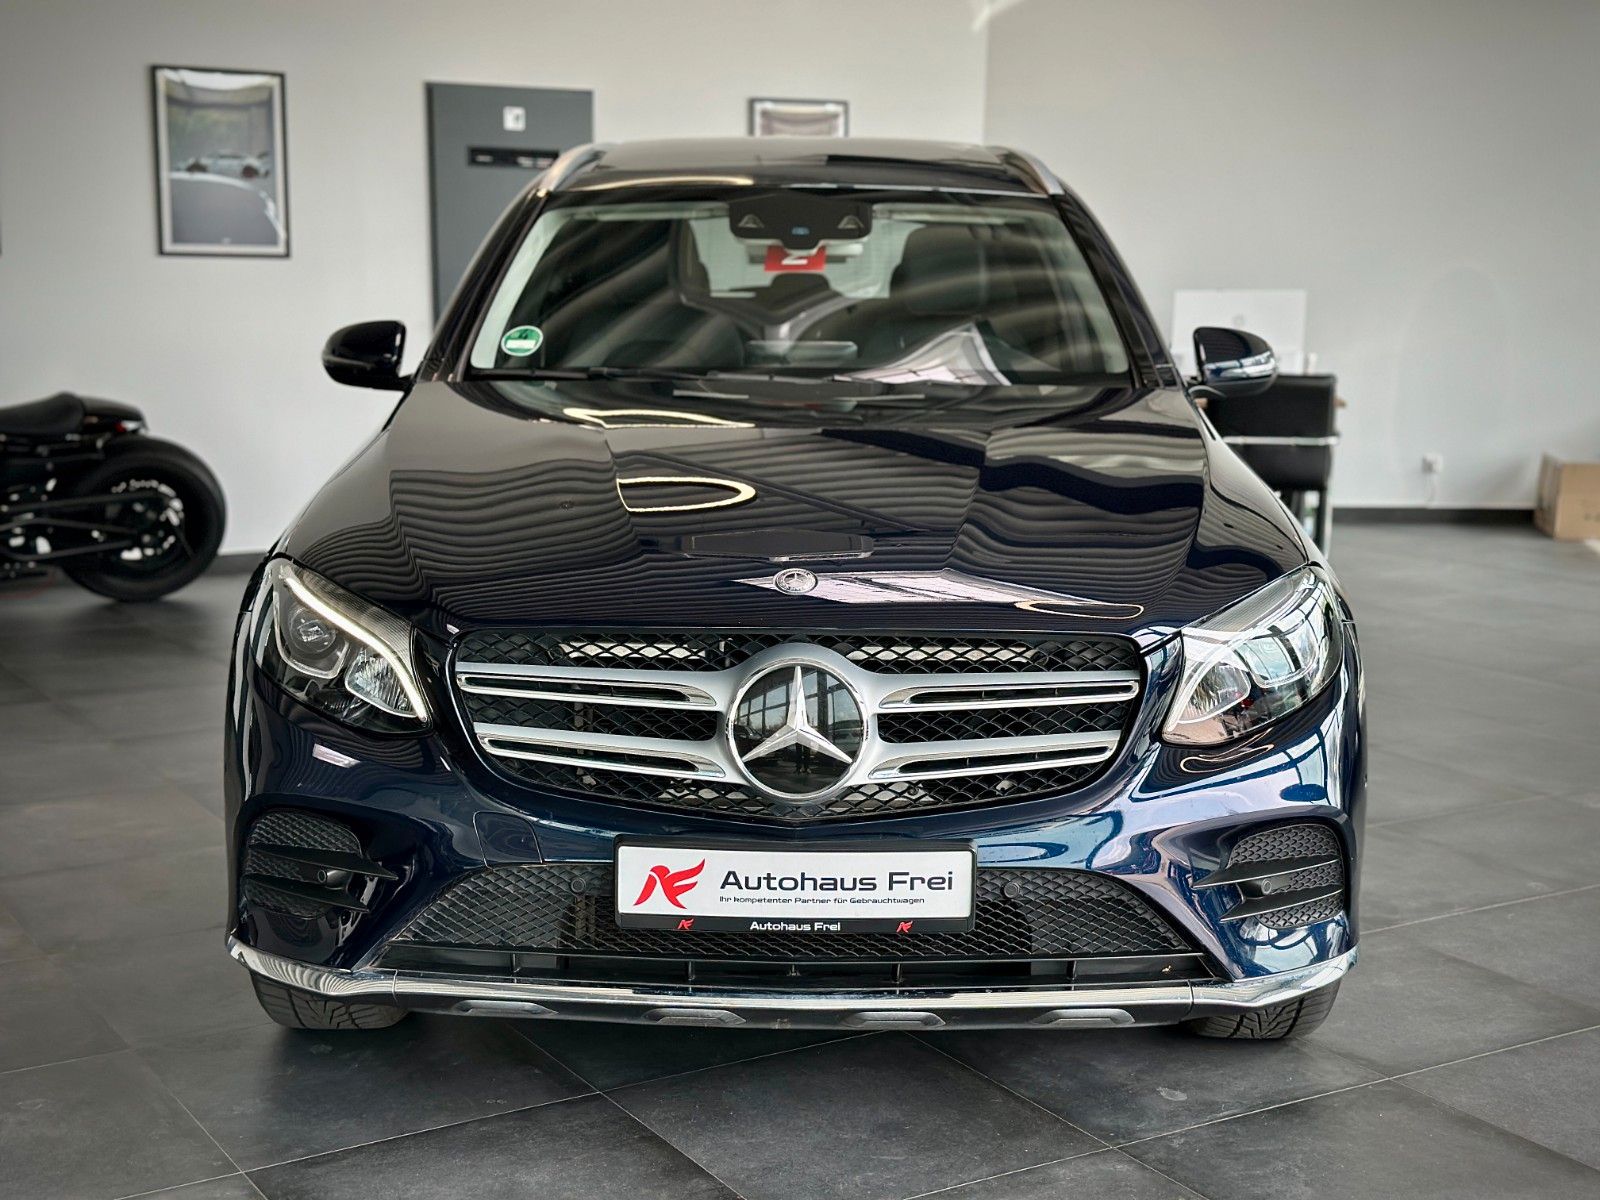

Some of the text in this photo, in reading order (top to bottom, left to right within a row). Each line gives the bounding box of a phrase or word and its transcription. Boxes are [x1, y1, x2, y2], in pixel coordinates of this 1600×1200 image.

[720, 870, 953, 892] Autohaus Frei
[733, 896, 793, 905] kompetenter
[849, 897, 925, 905] Gebrauchtwagen
[749, 921, 841, 931] Autohaus Frei
